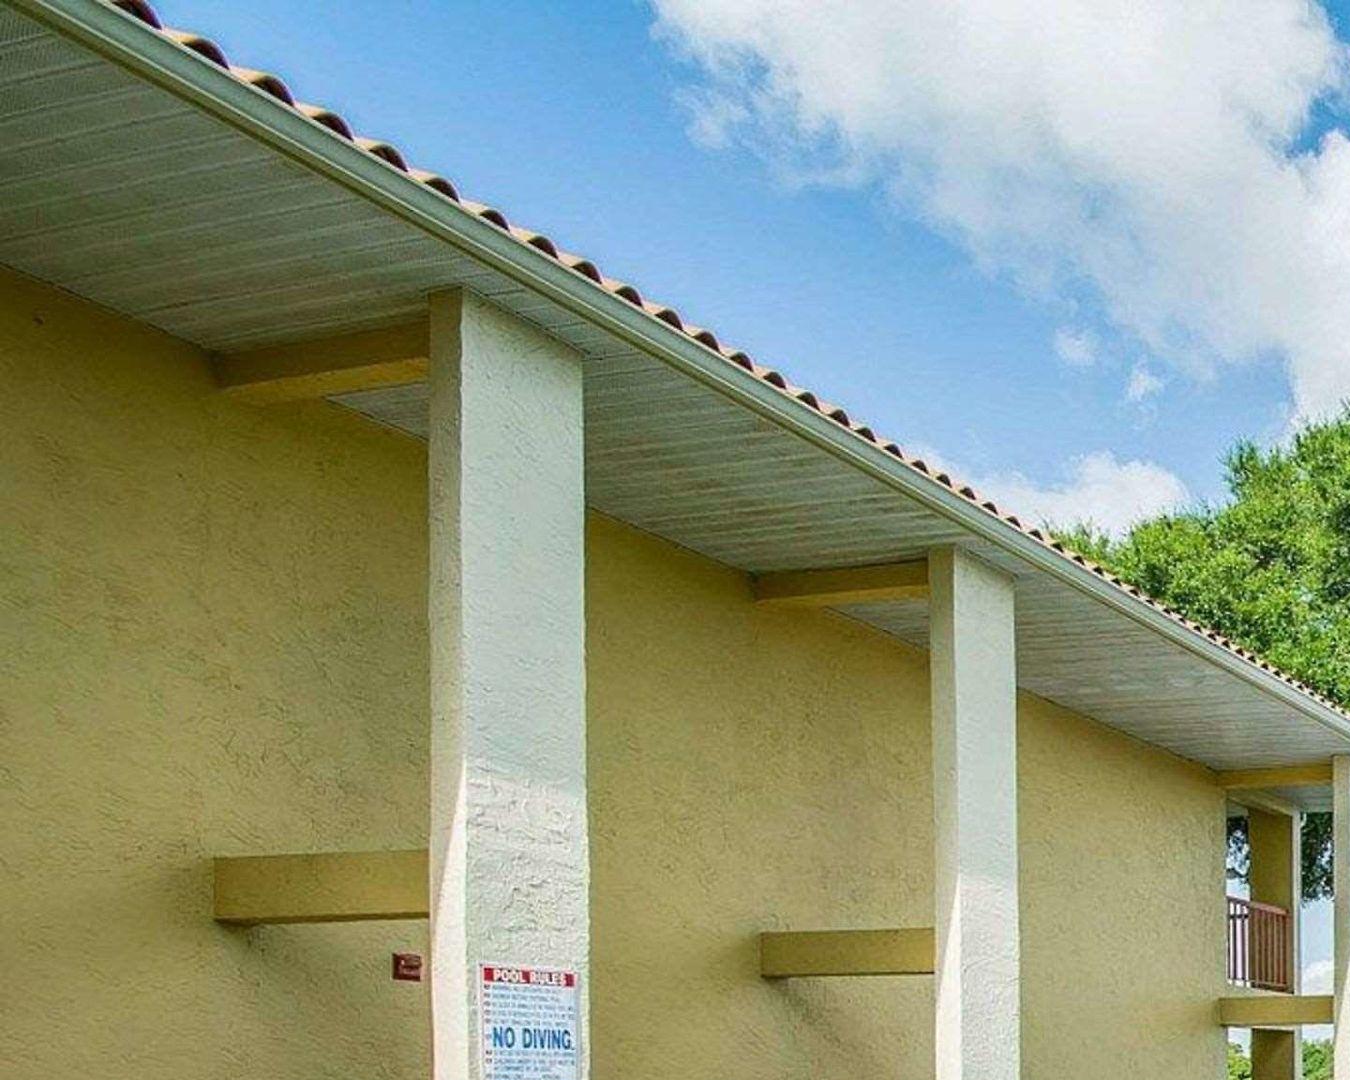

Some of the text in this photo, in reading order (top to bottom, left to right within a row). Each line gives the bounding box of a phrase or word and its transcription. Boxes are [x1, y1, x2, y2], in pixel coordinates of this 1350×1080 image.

[492, 968, 567, 987] POOL RULES
[492, 1026, 516, 1048] NO
